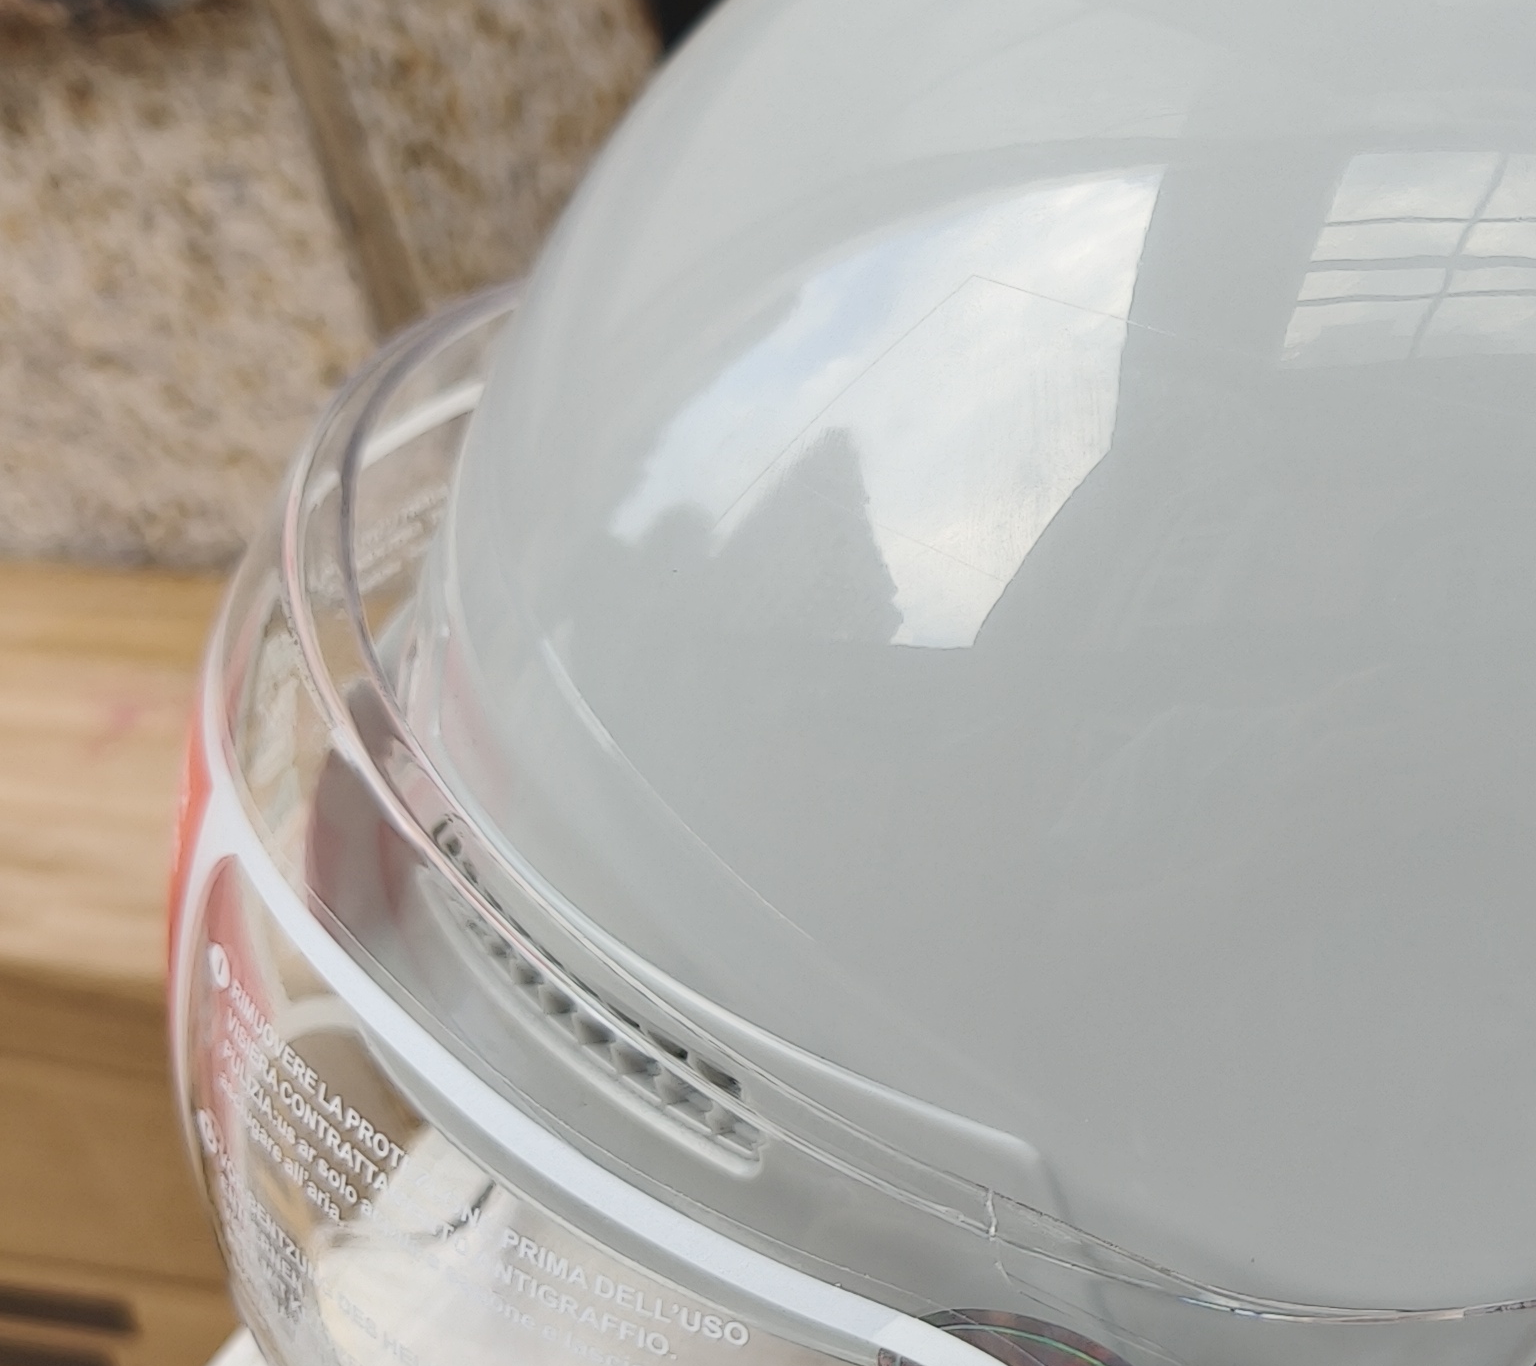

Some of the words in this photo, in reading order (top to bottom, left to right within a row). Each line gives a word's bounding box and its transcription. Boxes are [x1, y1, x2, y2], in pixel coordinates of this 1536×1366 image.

[226, 1006, 279, 1092] VISIERA
[230, 979, 318, 1095] RIMUOVERE
[318, 1082, 343, 1121] LA
[501, 1227, 589, 1291] PRIMA
[594, 1275, 749, 1346] DELL'USO
